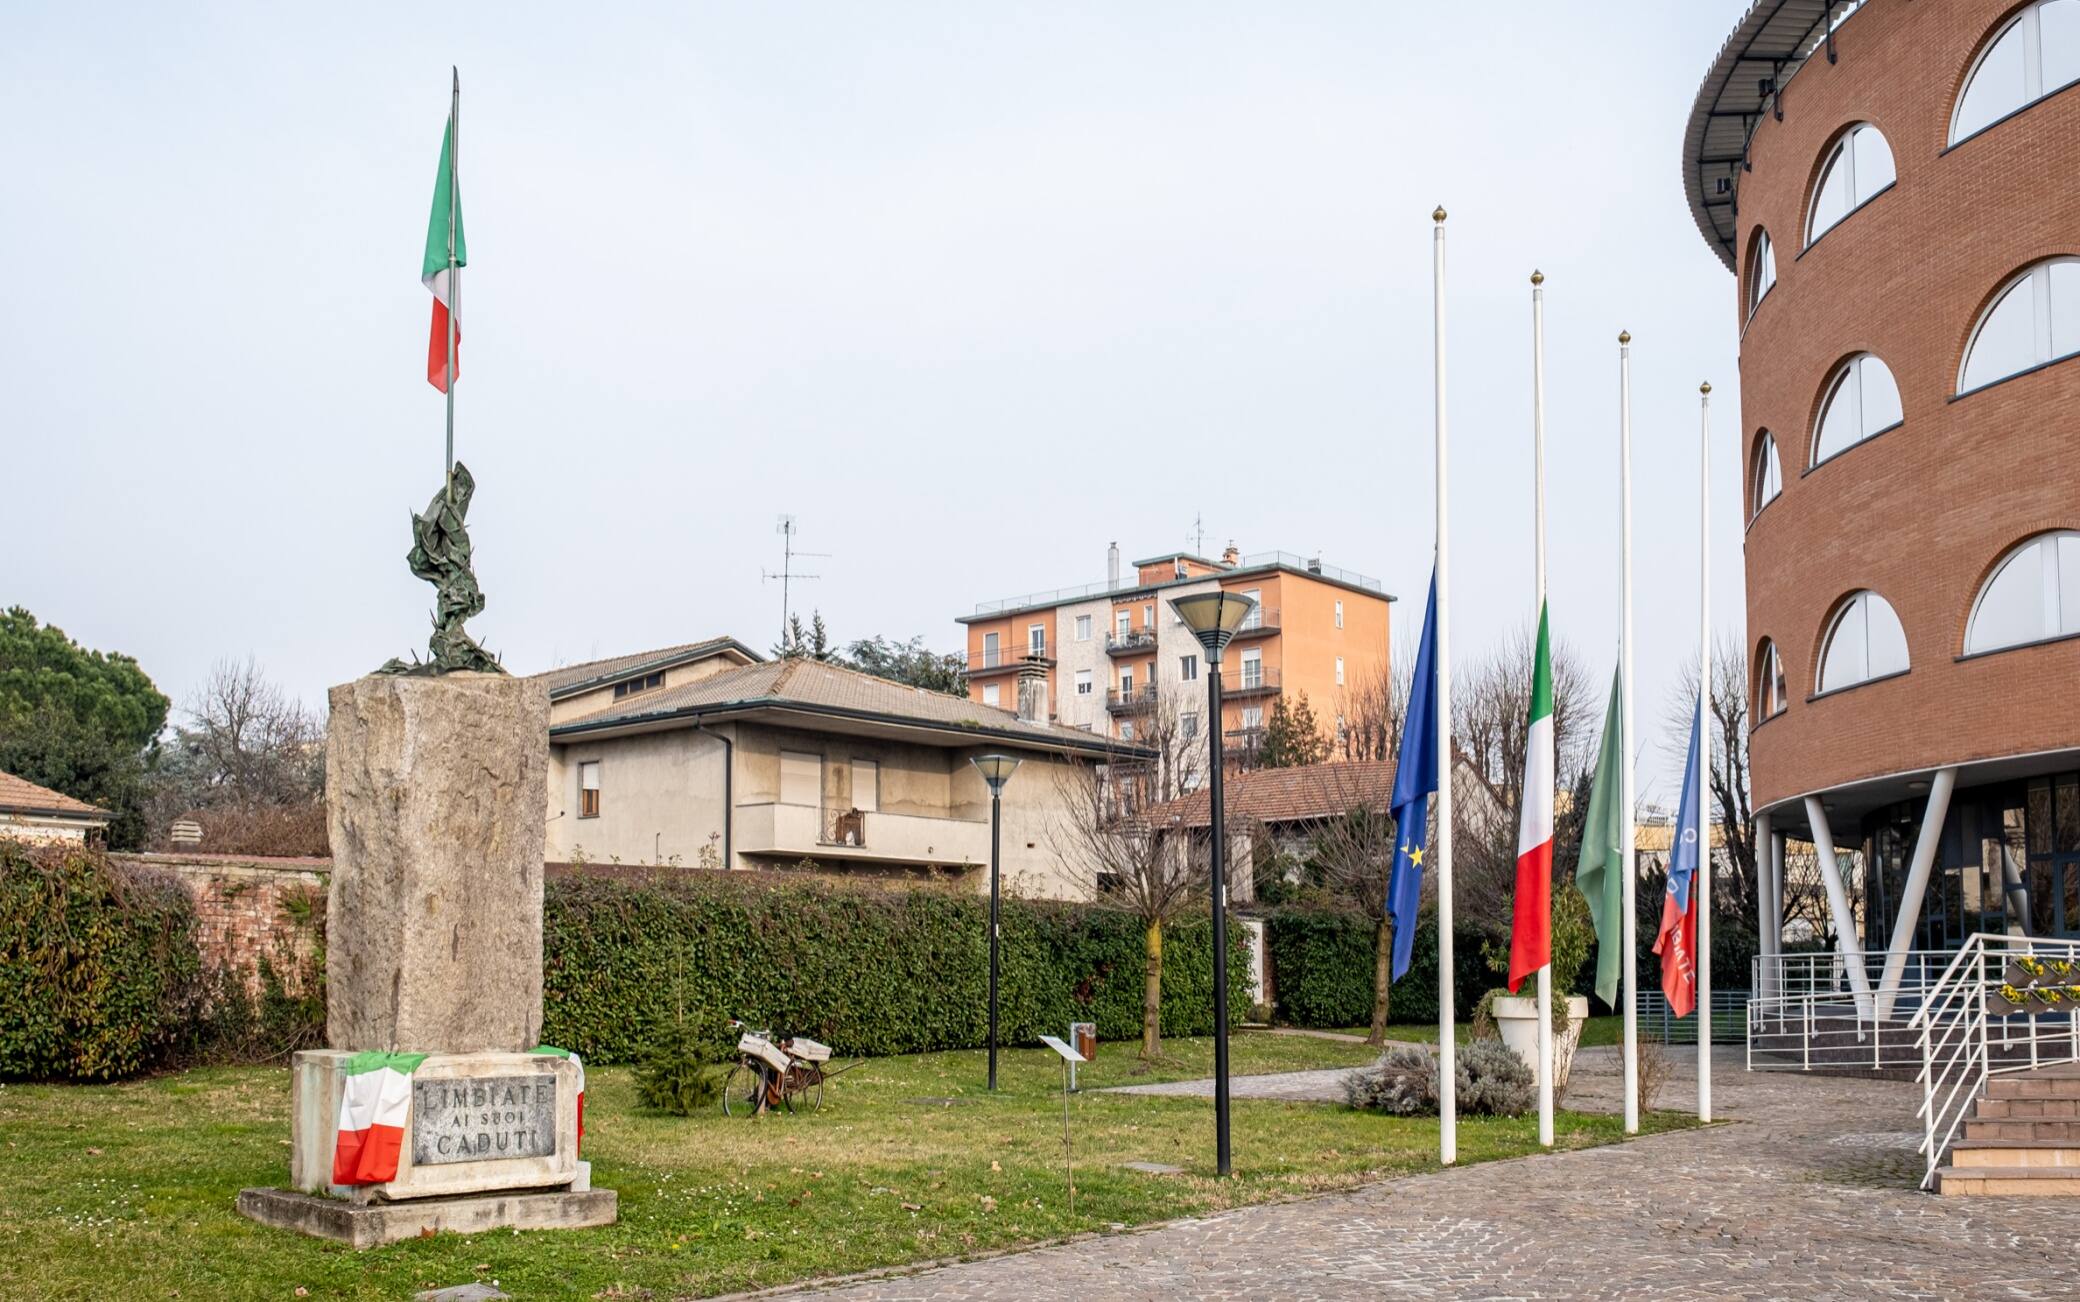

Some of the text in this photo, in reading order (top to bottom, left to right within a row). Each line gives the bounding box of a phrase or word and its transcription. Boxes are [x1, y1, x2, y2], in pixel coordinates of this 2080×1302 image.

[423, 1084, 549, 1110] LIMBIATE
[451, 1111, 523, 1127] AI SUOI
[437, 1130, 537, 1155] CADUTI
